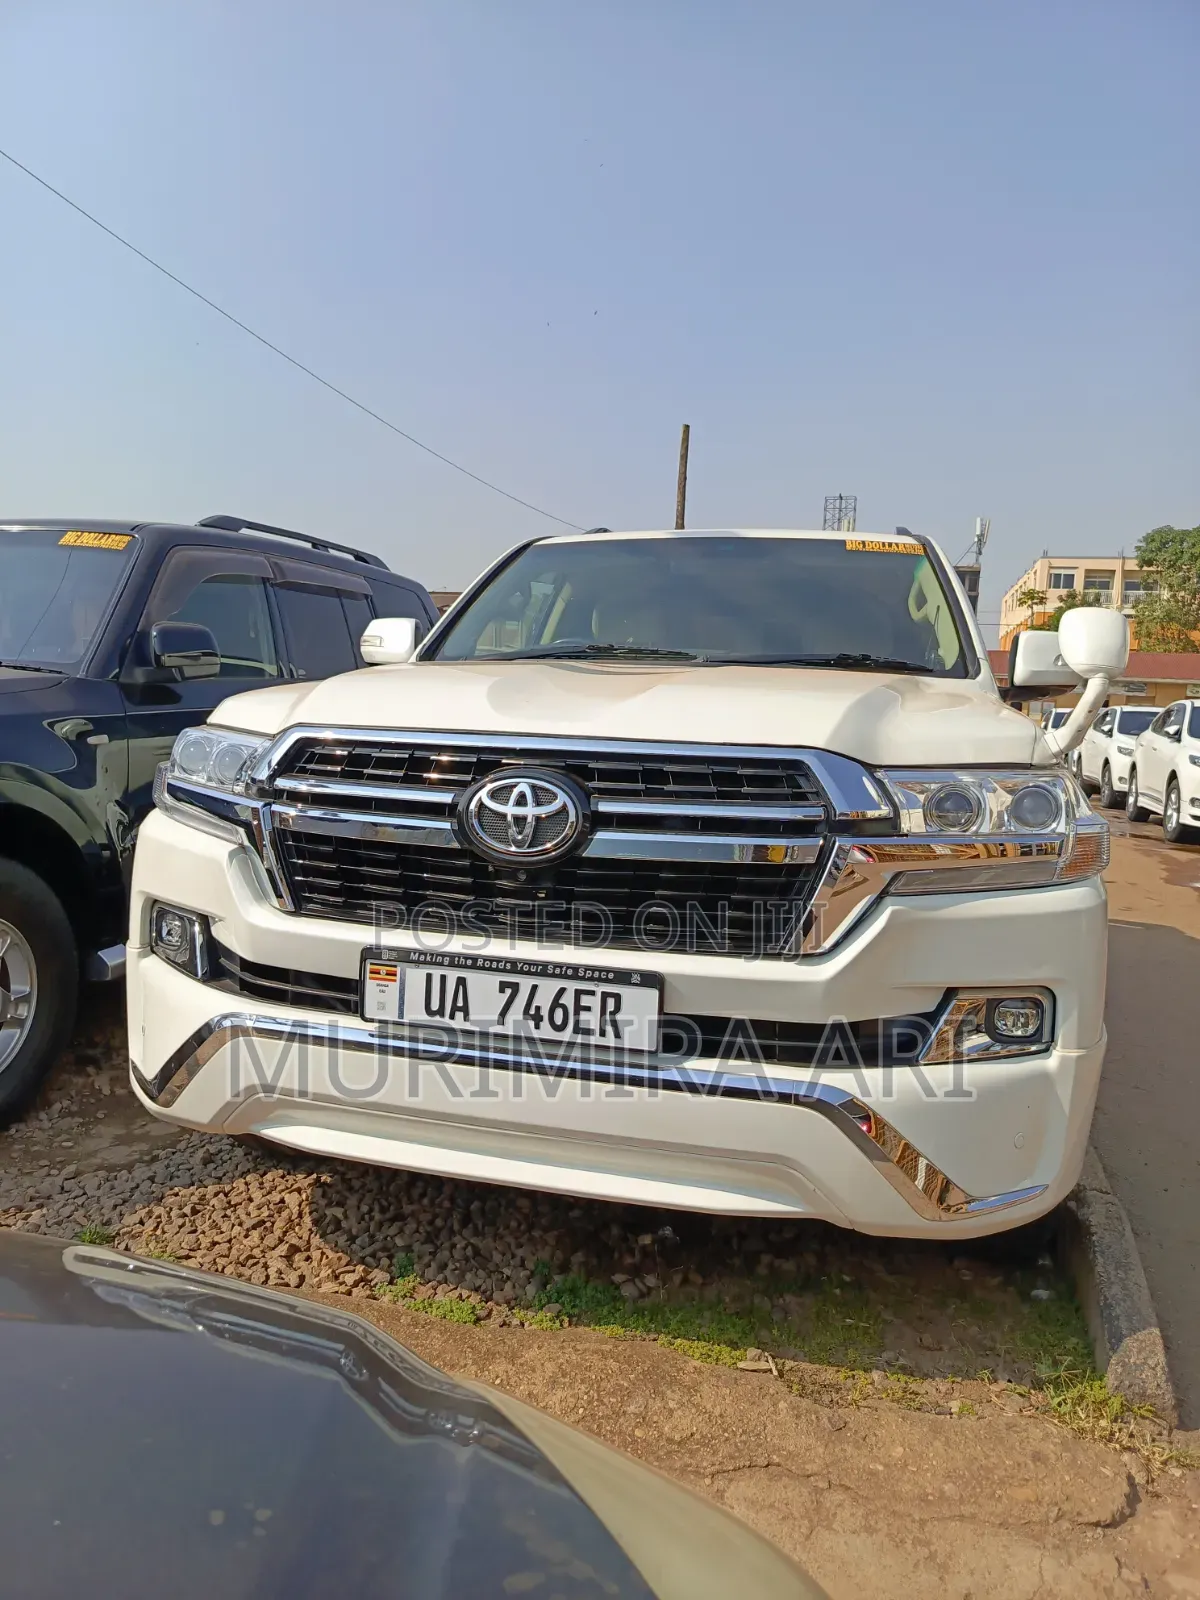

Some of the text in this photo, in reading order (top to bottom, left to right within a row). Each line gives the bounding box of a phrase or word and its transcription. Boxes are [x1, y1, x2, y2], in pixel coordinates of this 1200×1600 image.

[79, 532, 117, 546] DOLLAR
[845, 540, 863, 550] BIG
[865, 541, 906, 551] DOLLAR
[409, 952, 450, 966] Making
[454, 956, 473, 966] the
[476, 958, 512, 970] Roads
[516, 962, 543, 973] Your
[547, 965, 573, 976] Safe
[578, 968, 615, 979] Space
[424, 972, 622, 1039] UA 746ER
